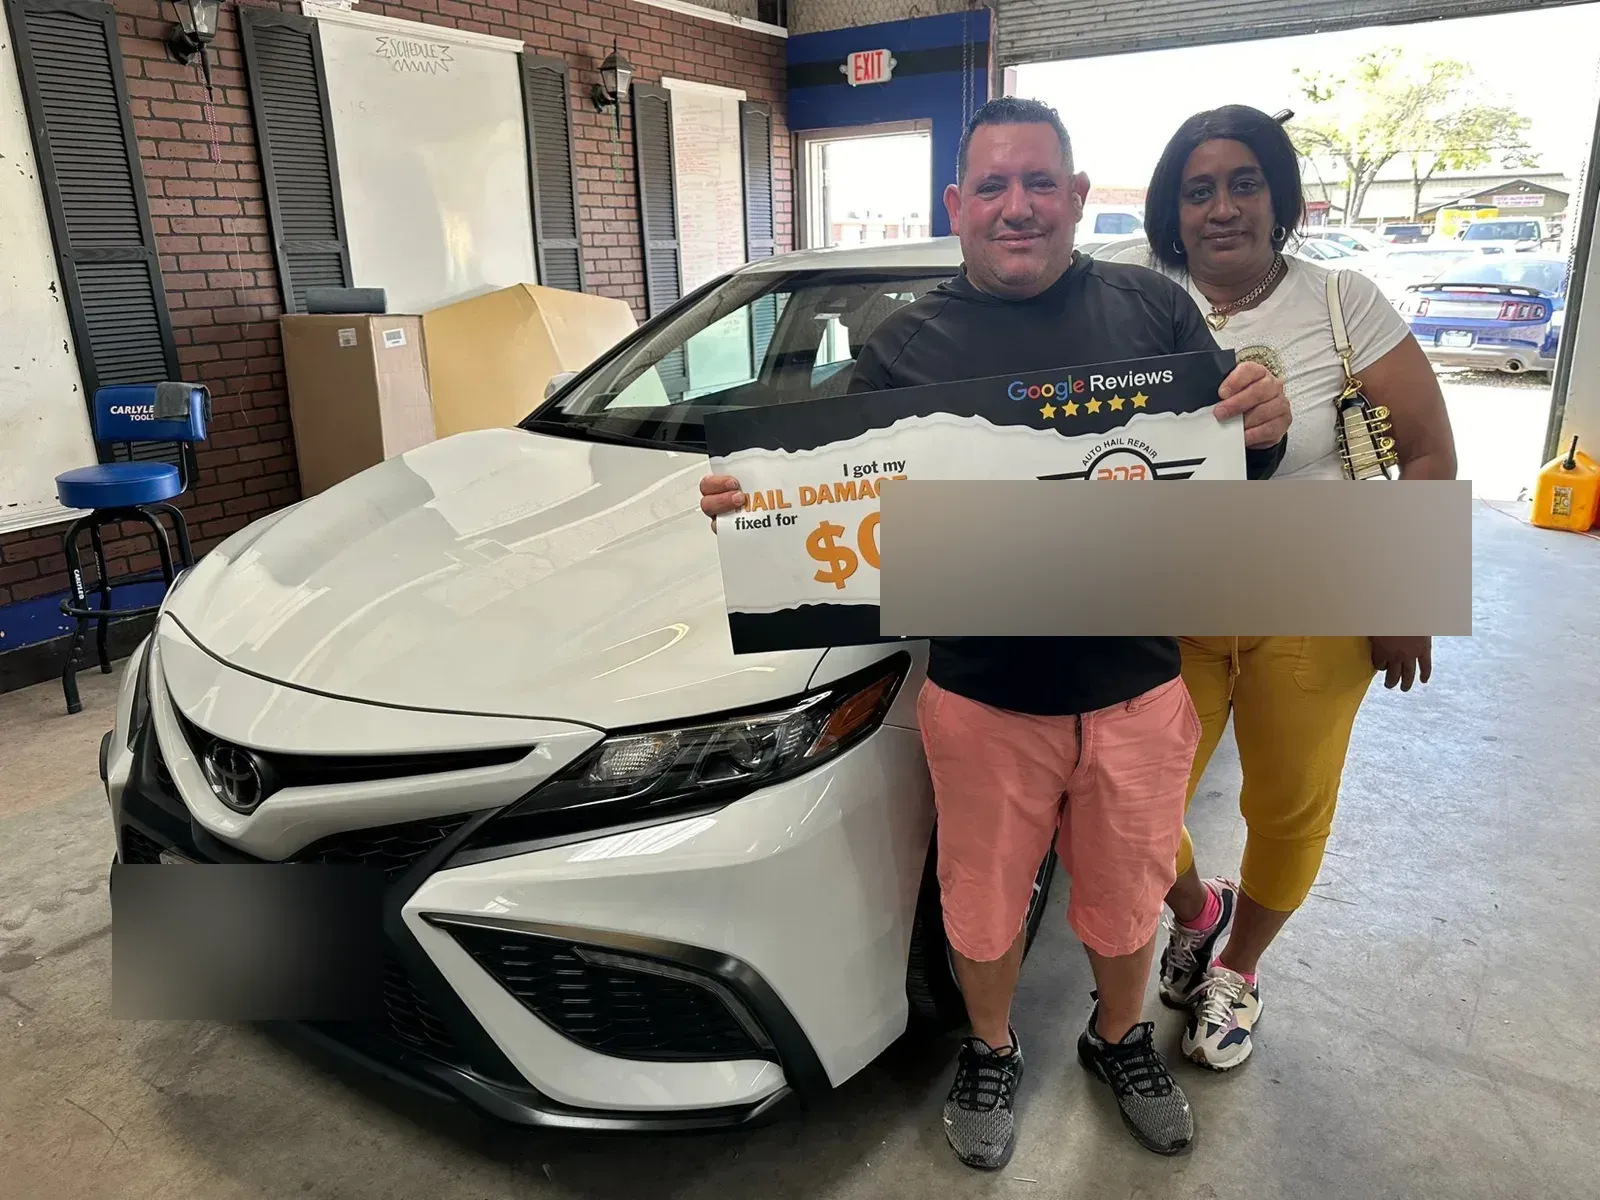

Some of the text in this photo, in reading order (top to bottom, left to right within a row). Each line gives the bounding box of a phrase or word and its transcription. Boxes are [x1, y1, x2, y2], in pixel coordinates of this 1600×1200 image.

[854, 51, 883, 82] EXIT
[1007, 369, 1174, 401] Google Reviews
[110, 405, 154, 415] CARLYLE
[1082, 437, 1158, 466] AUTO HAIL REPAIR
[843, 460, 906, 478] I got my
[799, 475, 908, 506] DAMA
[735, 513, 798, 530] fixed for
